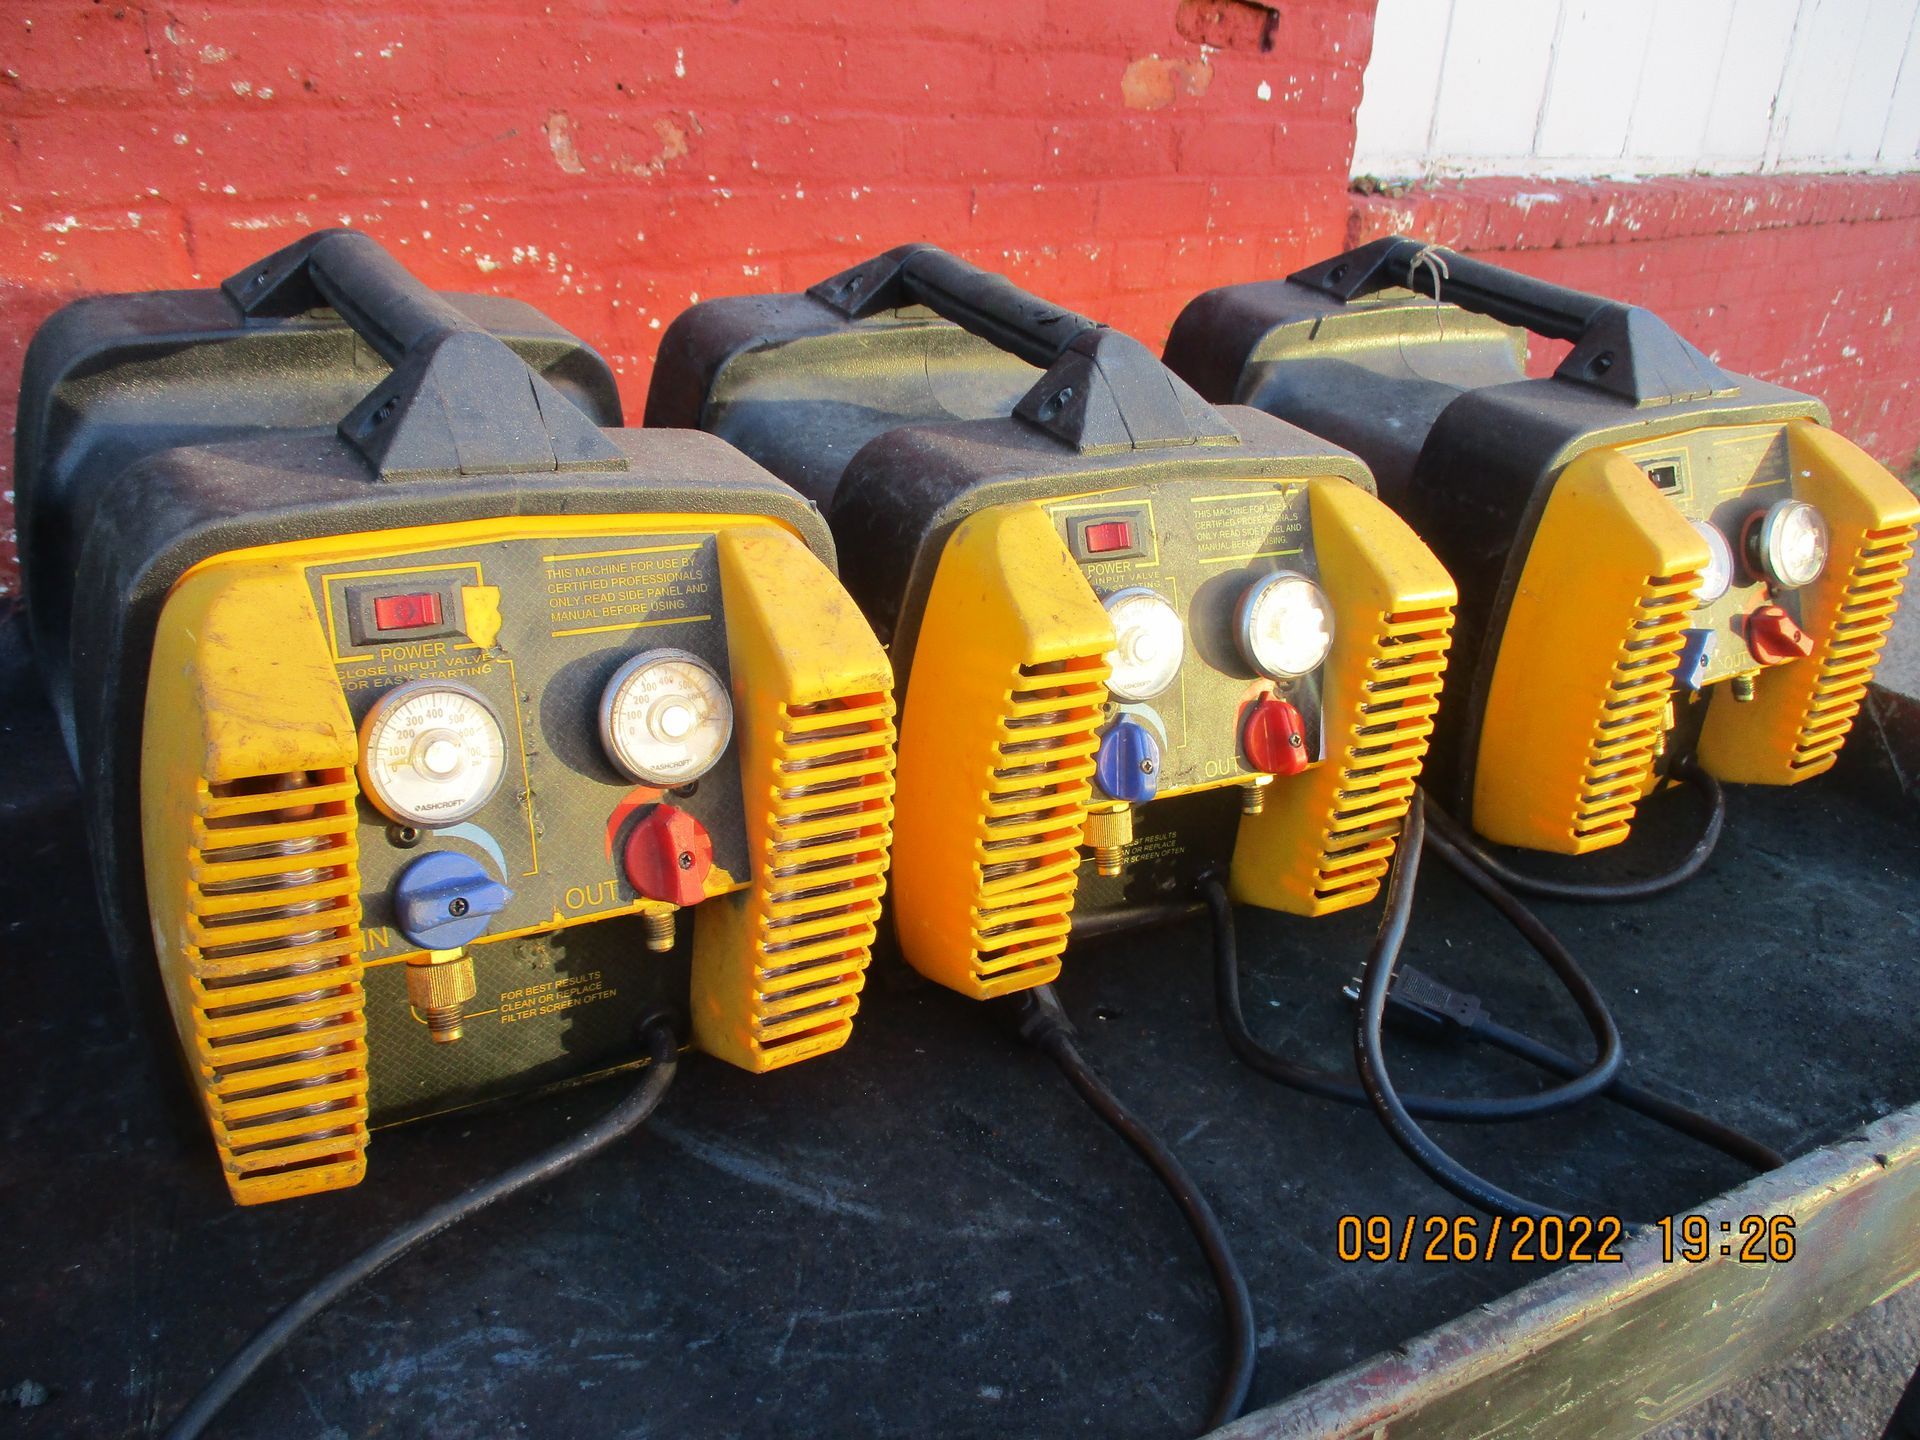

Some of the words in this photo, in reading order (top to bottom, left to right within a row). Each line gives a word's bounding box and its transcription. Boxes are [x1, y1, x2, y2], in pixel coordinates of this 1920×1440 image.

[1193, 510, 1211, 518] THIS
[1212, 505, 1249, 517] MACHINE
[1249, 504, 1265, 513] FOR
[1266, 503, 1280, 511] USE
[1194, 519, 1235, 530] CERTIFIED
[1196, 531, 1217, 541] ONLY
[1219, 530, 1241, 539] READ
[1241, 527, 1259, 537] SIDE
[1286, 523, 1302, 532] AND
[1197, 542, 1231, 552] MANUAL
[545, 567, 572, 580] THIS
[575, 562, 627, 578] MACHINE
[630, 560, 654, 572] FOR
[656, 558, 679, 570] USE
[681, 557, 696, 568] BY
[1087, 561, 1132, 576] POWER
[547, 578, 608, 594] CERTIFIED
[611, 569, 703, 587] PROFESSIONALS
[1095, 575, 1125, 585] INPUT
[1131, 571, 1160, 581] VALVE
[549, 596, 580, 609] ONLY
[584, 592, 616, 606] READ
[618, 589, 645, 603] SIDE
[647, 586, 683, 599] PANEL
[685, 583, 708, 594] AND
[551, 610, 600, 623] MANUAL
[602, 603, 648, 617] BEFORE
[650, 599, 688, 612] USING.
[380, 642, 446, 663] POWER
[1725, 651, 1748, 669] OUT
[338, 665, 387, 680] CLOSE
[393, 660, 440, 673] INPUT
[444, 653, 492, 667] VALVE
[374, 674, 415, 688] EASY
[418, 662, 493, 680] STARTING
[659, 675, 674, 685] 400
[641, 682, 657, 693] 300
[633, 695, 650, 705] 200
[406, 715, 424, 727] 300
[426, 708, 444, 719] 400
[448, 713, 465, 725] 500
[627, 710, 643, 720] 100
[396, 728, 415, 740] 200
[629, 726, 636, 736] 0
[389, 745, 407, 757] 100
[1205, 756, 1241, 778] OUT
[420, 799, 462, 811] ASHCROFT
[1131, 846, 1143, 854] OR
[1144, 840, 1177, 851] REPLACE
[1131, 852, 1160, 863] SCREEN
[1161, 847, 1185, 857] OFTEN
[565, 879, 619, 910] OUT
[361, 926, 390, 953] IN
[500, 989, 523, 1001] FOR
[525, 982, 553, 996] BEST
[554, 971, 601, 989] RESULTS
[500, 998, 536, 1013] CLEAN
[538, 993, 554, 1004] OR
[556, 981, 602, 999] REPLACE
[501, 1008, 537, 1024] FILTER
[539, 998, 581, 1015] SCREEN
[583, 988, 617, 1004] OFTEN
